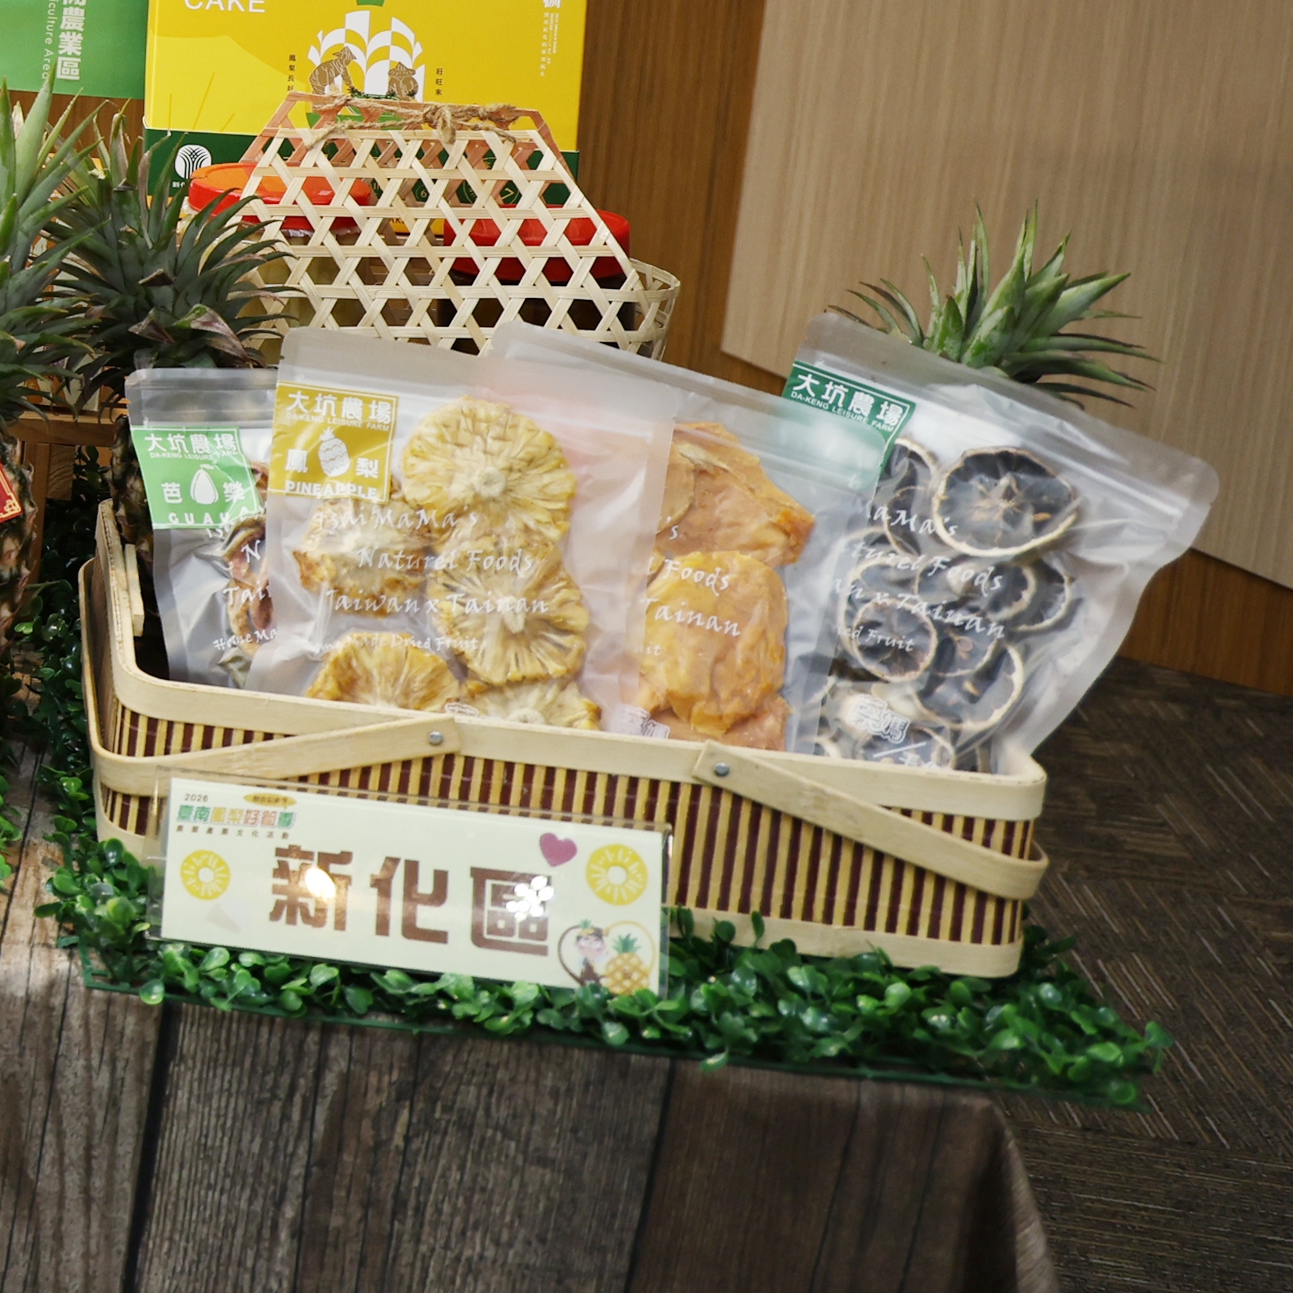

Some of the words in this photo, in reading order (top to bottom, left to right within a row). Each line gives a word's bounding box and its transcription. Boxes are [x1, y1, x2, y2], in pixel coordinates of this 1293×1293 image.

[287, 389, 393, 425] 大坑農場
[790, 390, 830, 411] DA-KENG
[831, 406, 869, 426] LEISURE
[870, 420, 895, 433] FARM
[792, 373, 904, 427] 大坑農場
[144, 432, 238, 456] 大坑農場
[366, 422, 390, 433] FARM
[284, 479, 379, 501] PINEAPPLE
[466, 548, 534, 579] Foods
[663, 558, 731, 597] Foods
[928, 555, 1004, 597] Foods
[327, 586, 423, 615] Taiwan
[445, 589, 549, 615] Tainan
[891, 592, 1006, 639] Tainan
[640, 598, 741, 637] Tainan
[435, 636, 480, 652] Fruit
[865, 628, 915, 653] Fruit
[184, 793, 209, 802] 2026
[269, 844, 554, 956] 新化區
